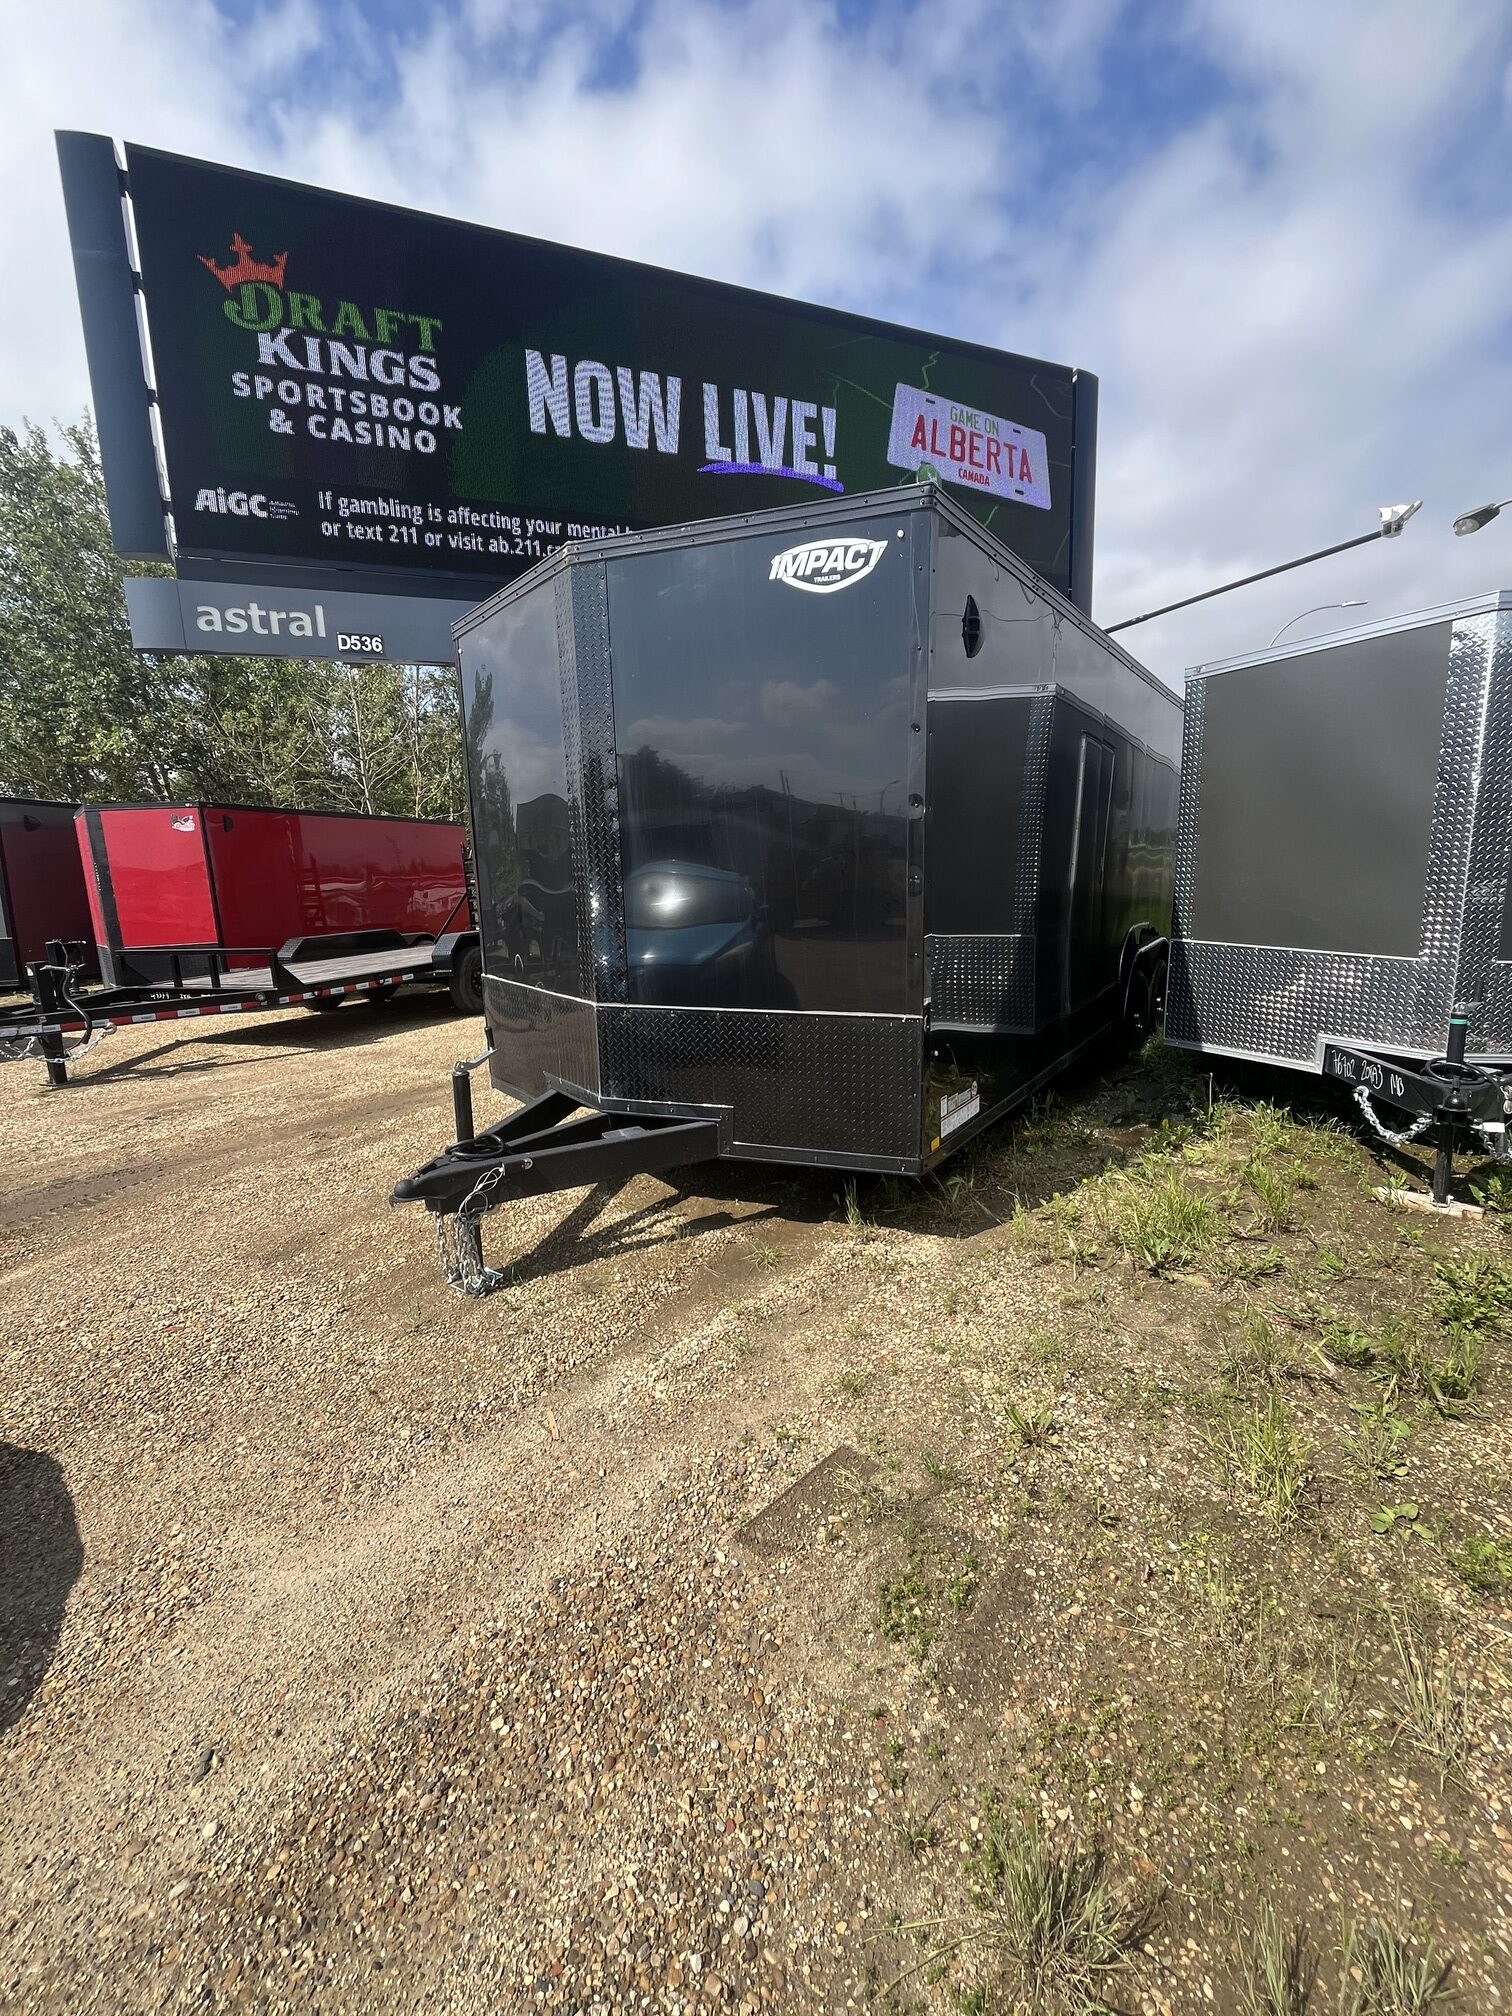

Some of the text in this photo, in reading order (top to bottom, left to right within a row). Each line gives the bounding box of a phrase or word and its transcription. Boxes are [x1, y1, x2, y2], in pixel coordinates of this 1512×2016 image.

[224, 282, 442, 351] DRAFT
[257, 327, 441, 392] KINGS
[231, 371, 463, 429] SPORTSBOOK
[526, 349, 837, 480] NOW LIVE!
[269, 408, 437, 453] & CASINO
[950, 406, 1000, 437] GAME ON
[911, 414, 1033, 484] ALBERTA
[958, 467, 991, 487] CANADA
[318, 490, 333, 510] If
[338, 497, 424, 525] gambling
[427, 502, 443, 522] is
[447, 505, 521, 535] affecting
[526, 518, 562, 537] your
[321, 520, 342, 537] or
[346, 521, 383, 542] text
[388, 524, 418, 545] 211
[425, 531, 443, 547] or
[449, 531, 484, 551] visit
[768, 540, 888, 580] IMPACT
[814, 574, 841, 583] TRAILERS
[196, 603, 326, 637] astral
[337, 633, 383, 653] D536
